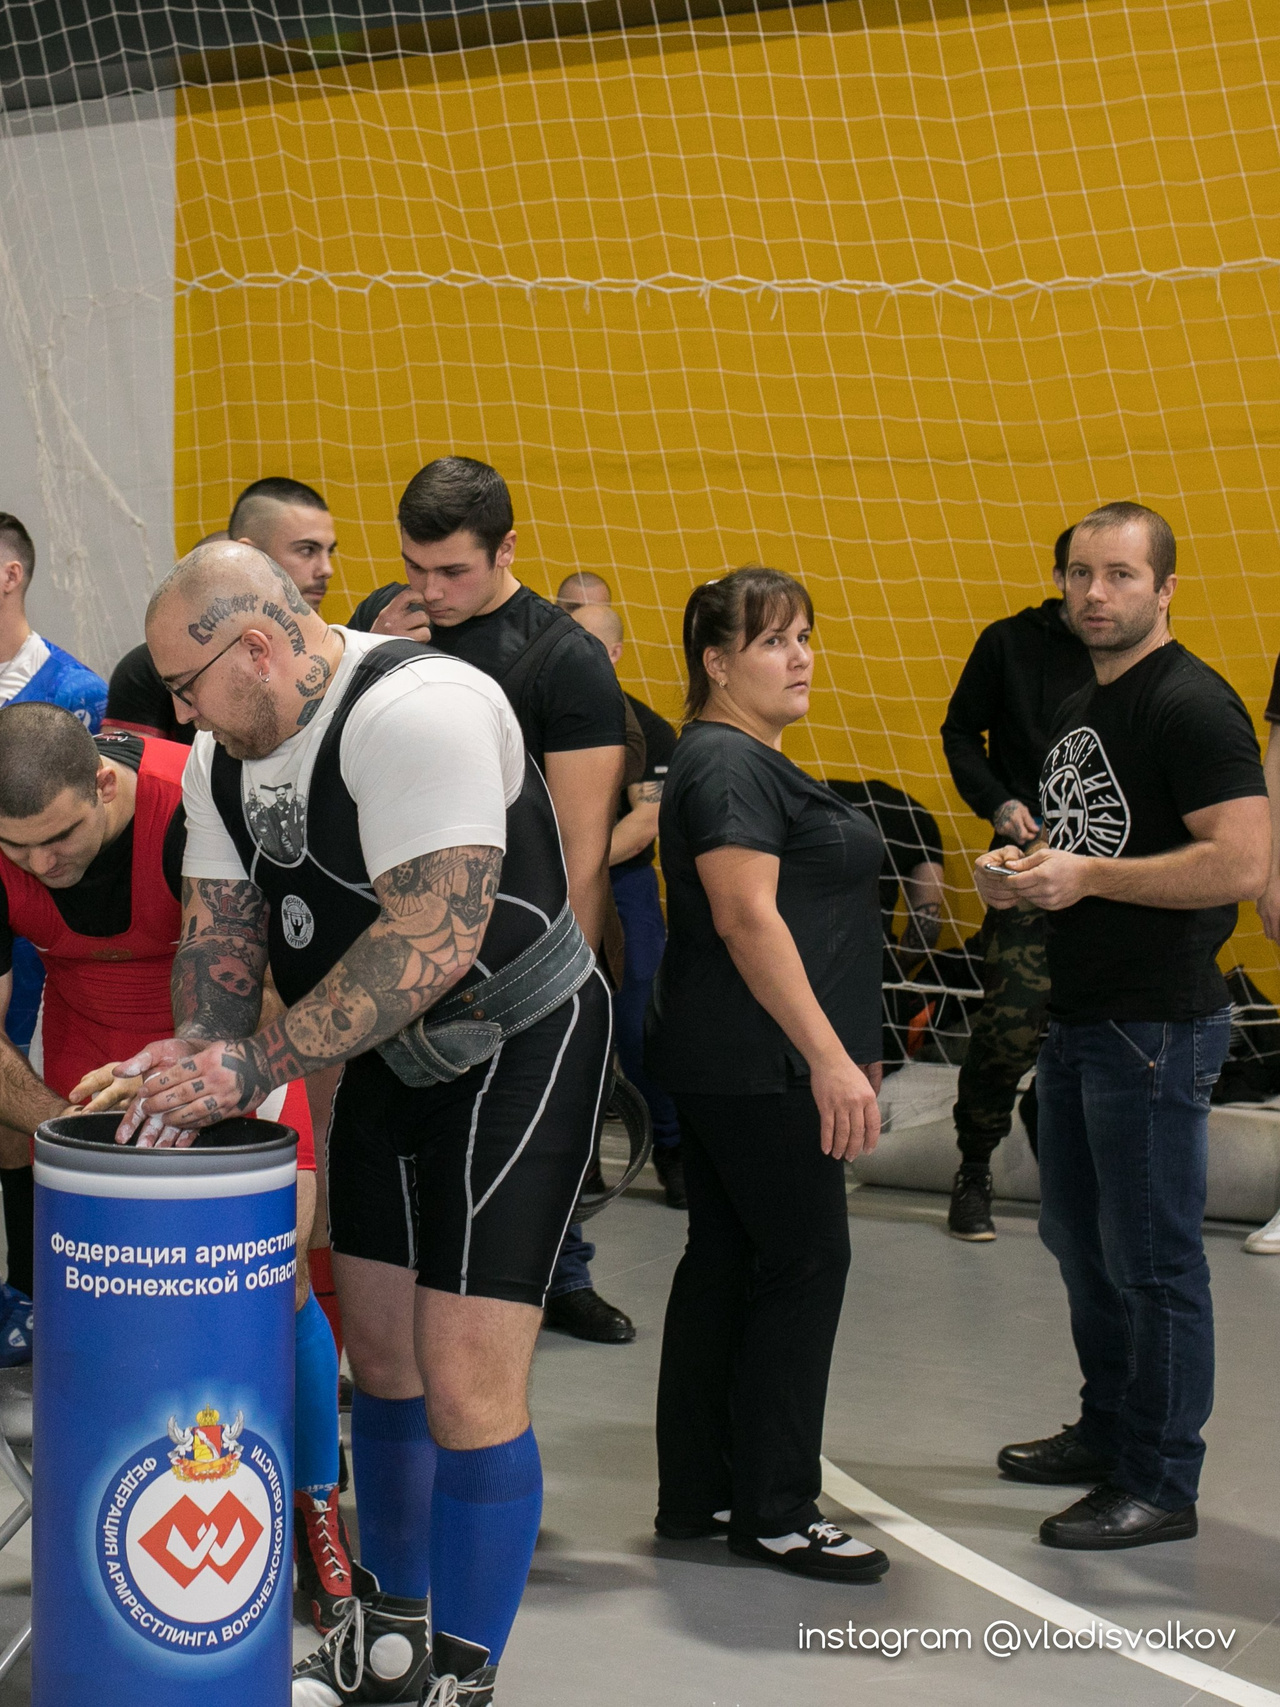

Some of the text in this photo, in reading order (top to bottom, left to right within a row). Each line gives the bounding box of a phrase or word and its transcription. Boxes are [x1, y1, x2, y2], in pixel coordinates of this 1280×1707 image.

[286, 933, 309, 947] LIFTING
[50, 1228, 297, 1268] Федерация армрестли
[65, 1266, 238, 1298] Воронежской
[102, 1444, 284, 1648] ФЕДЕРАЦИЯ АРМРЕСТЛИНГА ВОРОНЕЖСКОЙ ОБЛАСТИ
